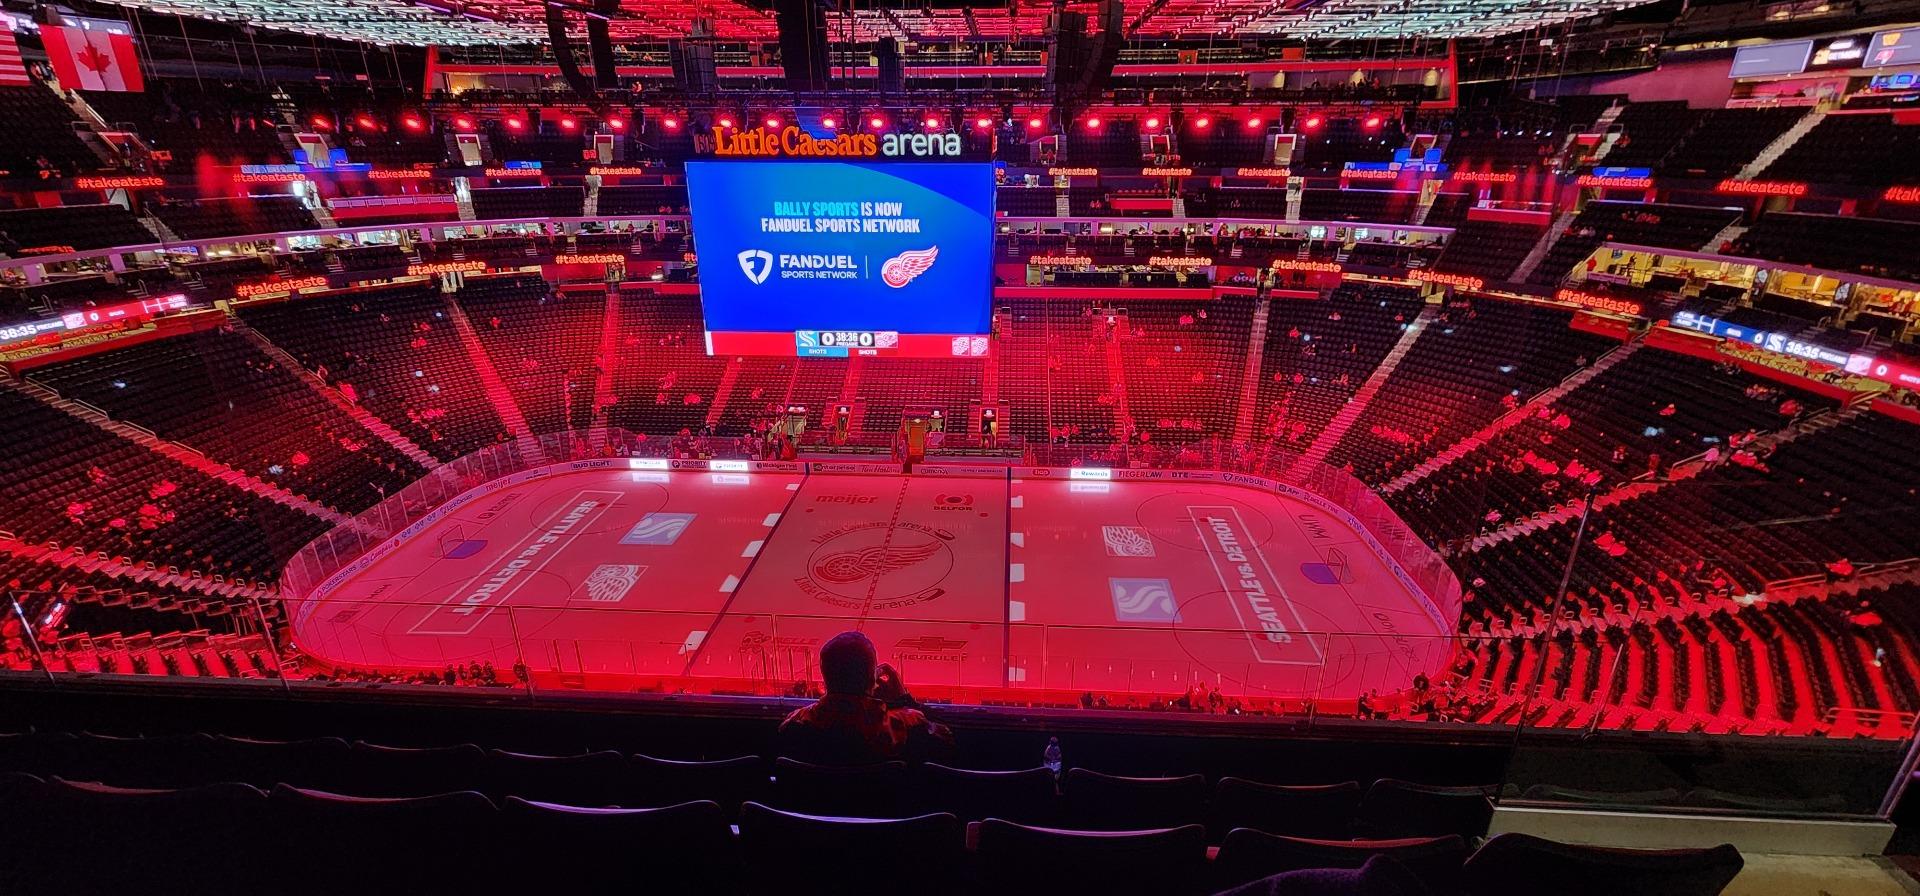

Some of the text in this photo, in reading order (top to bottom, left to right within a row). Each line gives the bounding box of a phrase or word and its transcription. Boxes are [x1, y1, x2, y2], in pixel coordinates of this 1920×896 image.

[712, 126, 779, 156] Little
[782, 126, 877, 156] Caesars
[882, 132, 961, 156] arena
[232, 172, 306, 183] #takeataste
[368, 169, 431, 179] #takeataste
[486, 167, 541, 177] #takeataste
[590, 166, 642, 176] #takeataste
[1049, 168, 1098, 177] #takeataste
[1142, 168, 1192, 177] #takeataste
[1238, 168, 1292, 177] #takeataste
[1341, 169, 1398, 179] #takeataste
[1453, 171, 1516, 182] #takeataste
[78, 175, 164, 189] #takeataste
[1577, 175, 1652, 187] #takeataste
[1720, 180, 1805, 195] #takeataste
[774, 202, 903, 217] BALLY SPORTS IS NOW
[761, 218, 920, 233] FANDUEL SPORTS NETWORK
[556, 253, 625, 265] #takeataste
[779, 254, 857, 269] FANDUEL
[1030, 255, 1092, 266] #takeataste
[1149, 256, 1213, 267] #takeataste
[1272, 258, 1342, 273] #takeataste
[408, 259, 486, 276] #takeataste
[781, 271, 858, 279] SPORTS NETWORK
[1409, 269, 1483, 289] #takeataste
[238, 275, 327, 297] #takeataste
[1558, 288, 1640, 315] #takeataste
[822, 332, 872, 346] 0 38:36 0
[573, 460, 610, 470] BUD LIGHT
[486, 478, 512, 492] meijer
[1235, 475, 1268, 488] FANDUEL
[815, 494, 879, 505] meijer
[536, 500, 599, 544] SEATTLE
[1207, 516, 1247, 562] DETROIT
[321, 565, 357, 592] POKERSTARS
[452, 558, 532, 616] DETROIT
[873, 598, 917, 610] arena
[1240, 579, 1291, 643] SEATTLE
